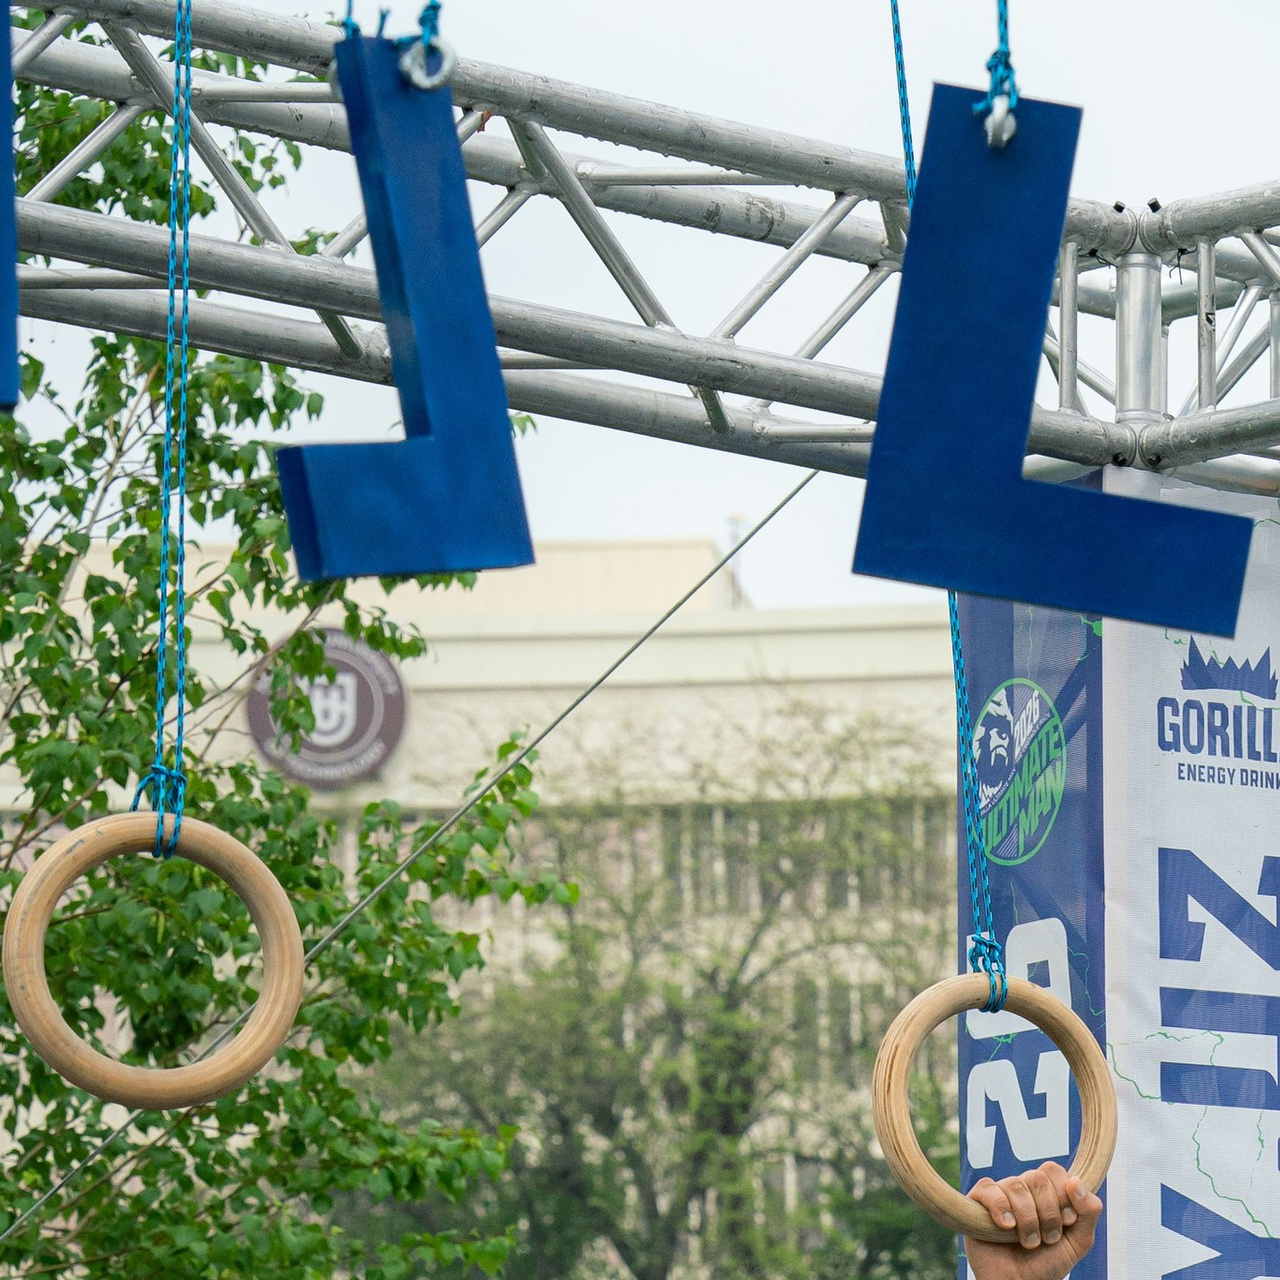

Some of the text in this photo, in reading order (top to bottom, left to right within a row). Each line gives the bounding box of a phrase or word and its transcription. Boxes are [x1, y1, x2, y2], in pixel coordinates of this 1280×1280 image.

[1014, 690, 1040, 759] 2026
[981, 717, 1062, 850] ULTIMATE
[1018, 760, 1062, 857] MAN
[1177, 762, 1236, 785] ENERGY
